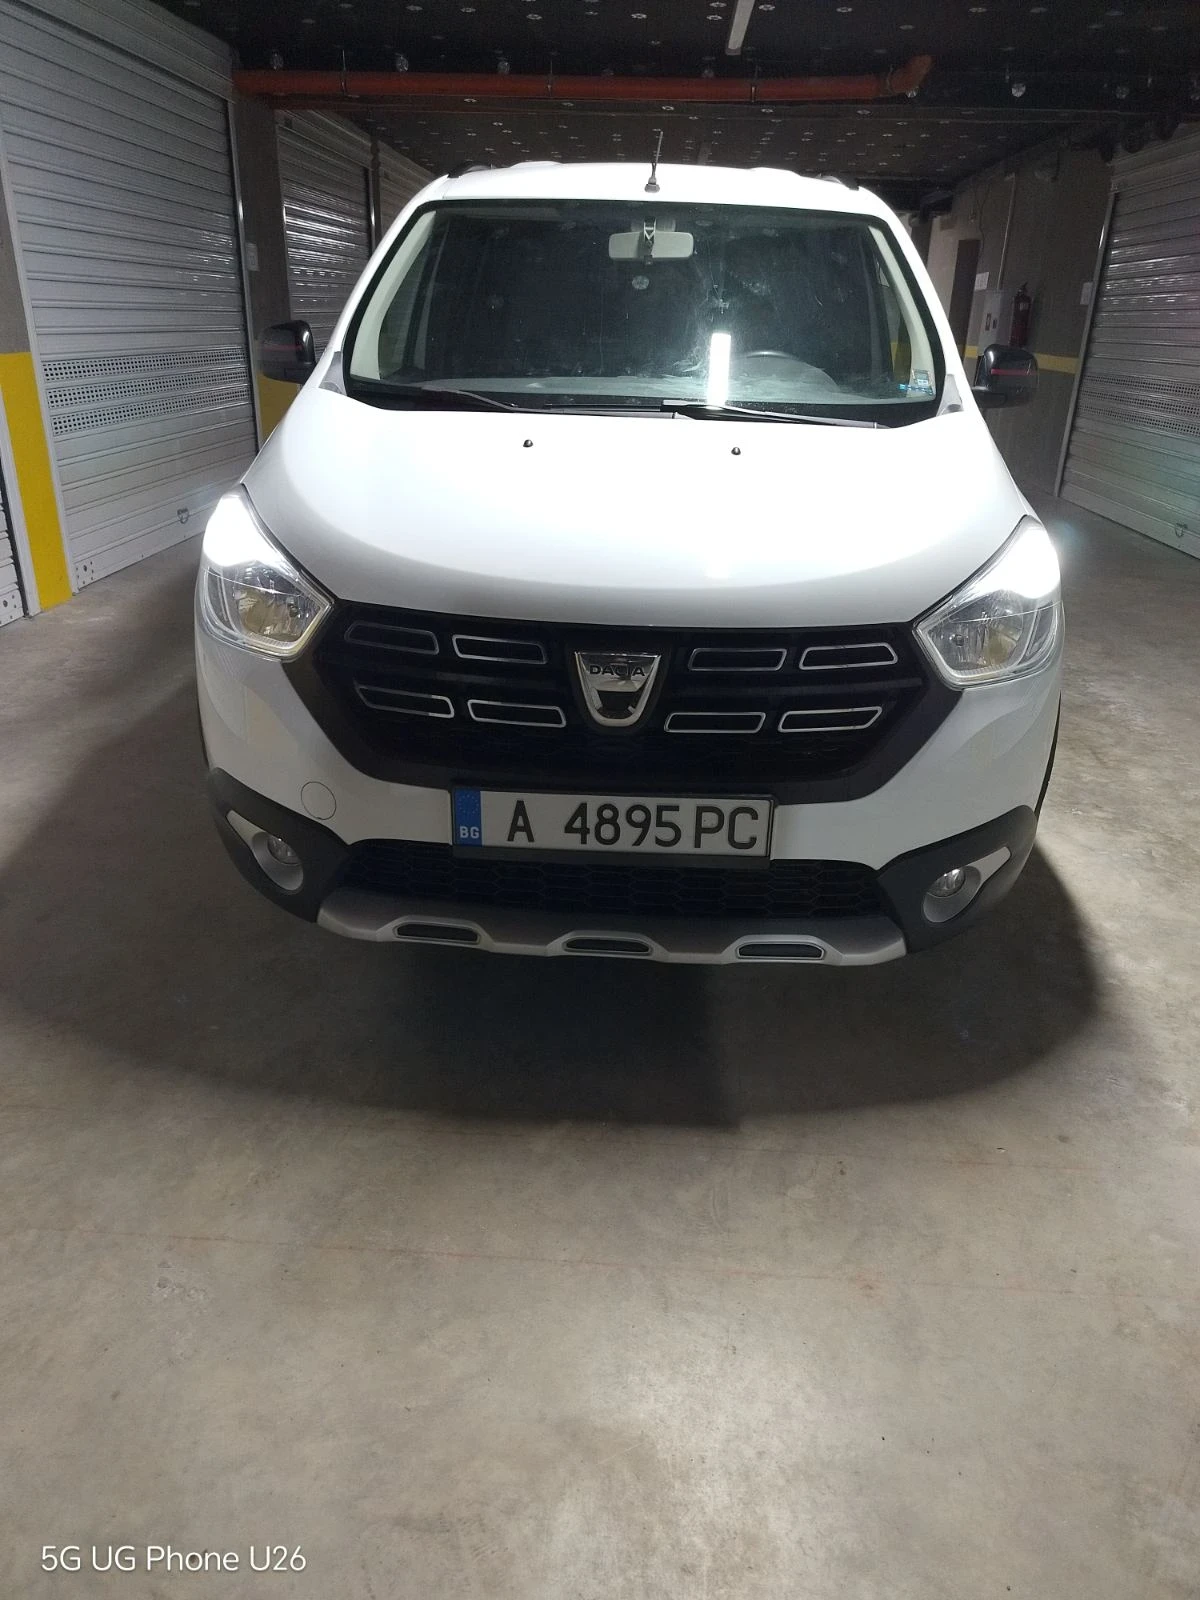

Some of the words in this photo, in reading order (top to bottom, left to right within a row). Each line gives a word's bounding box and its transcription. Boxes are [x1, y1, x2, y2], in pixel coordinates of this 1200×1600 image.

[589, 663, 645, 677] DACIA
[507, 799, 535, 842] A
[459, 824, 480, 840] BG
